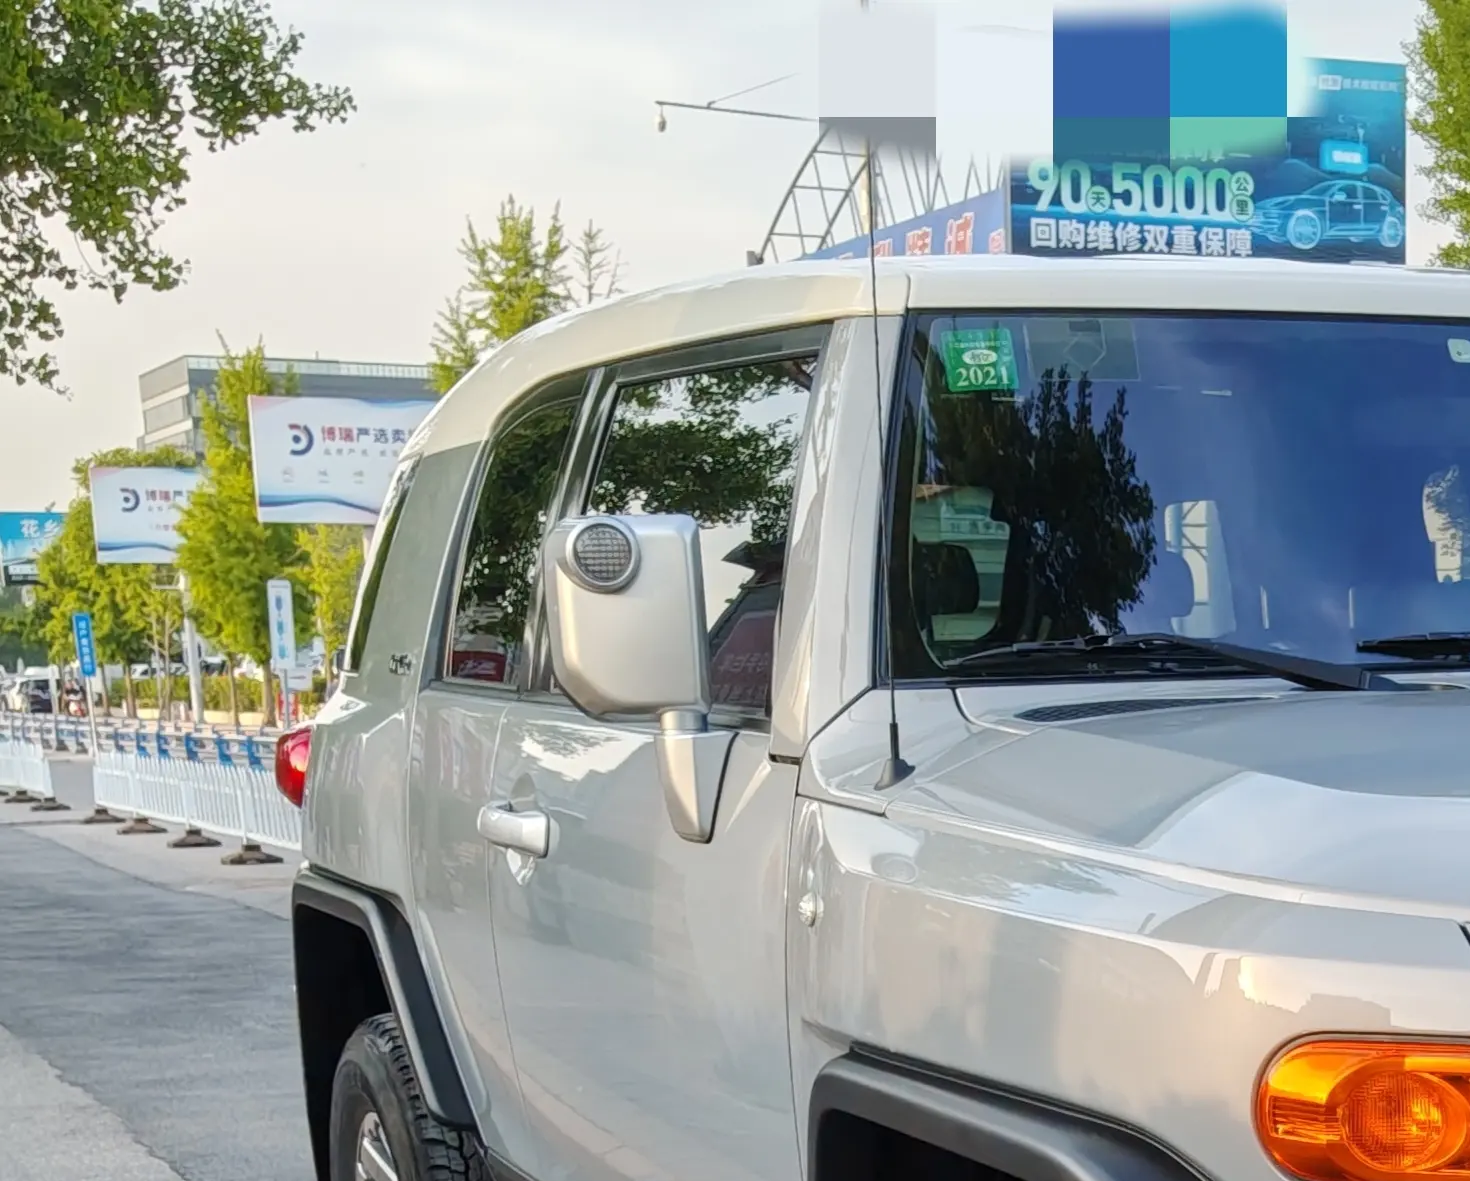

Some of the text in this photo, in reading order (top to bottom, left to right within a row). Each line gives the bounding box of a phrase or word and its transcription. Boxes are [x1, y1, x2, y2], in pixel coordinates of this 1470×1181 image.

[1030, 217, 1253, 257] 回购维修双重保障
[956, 366, 1011, 387] 2021
